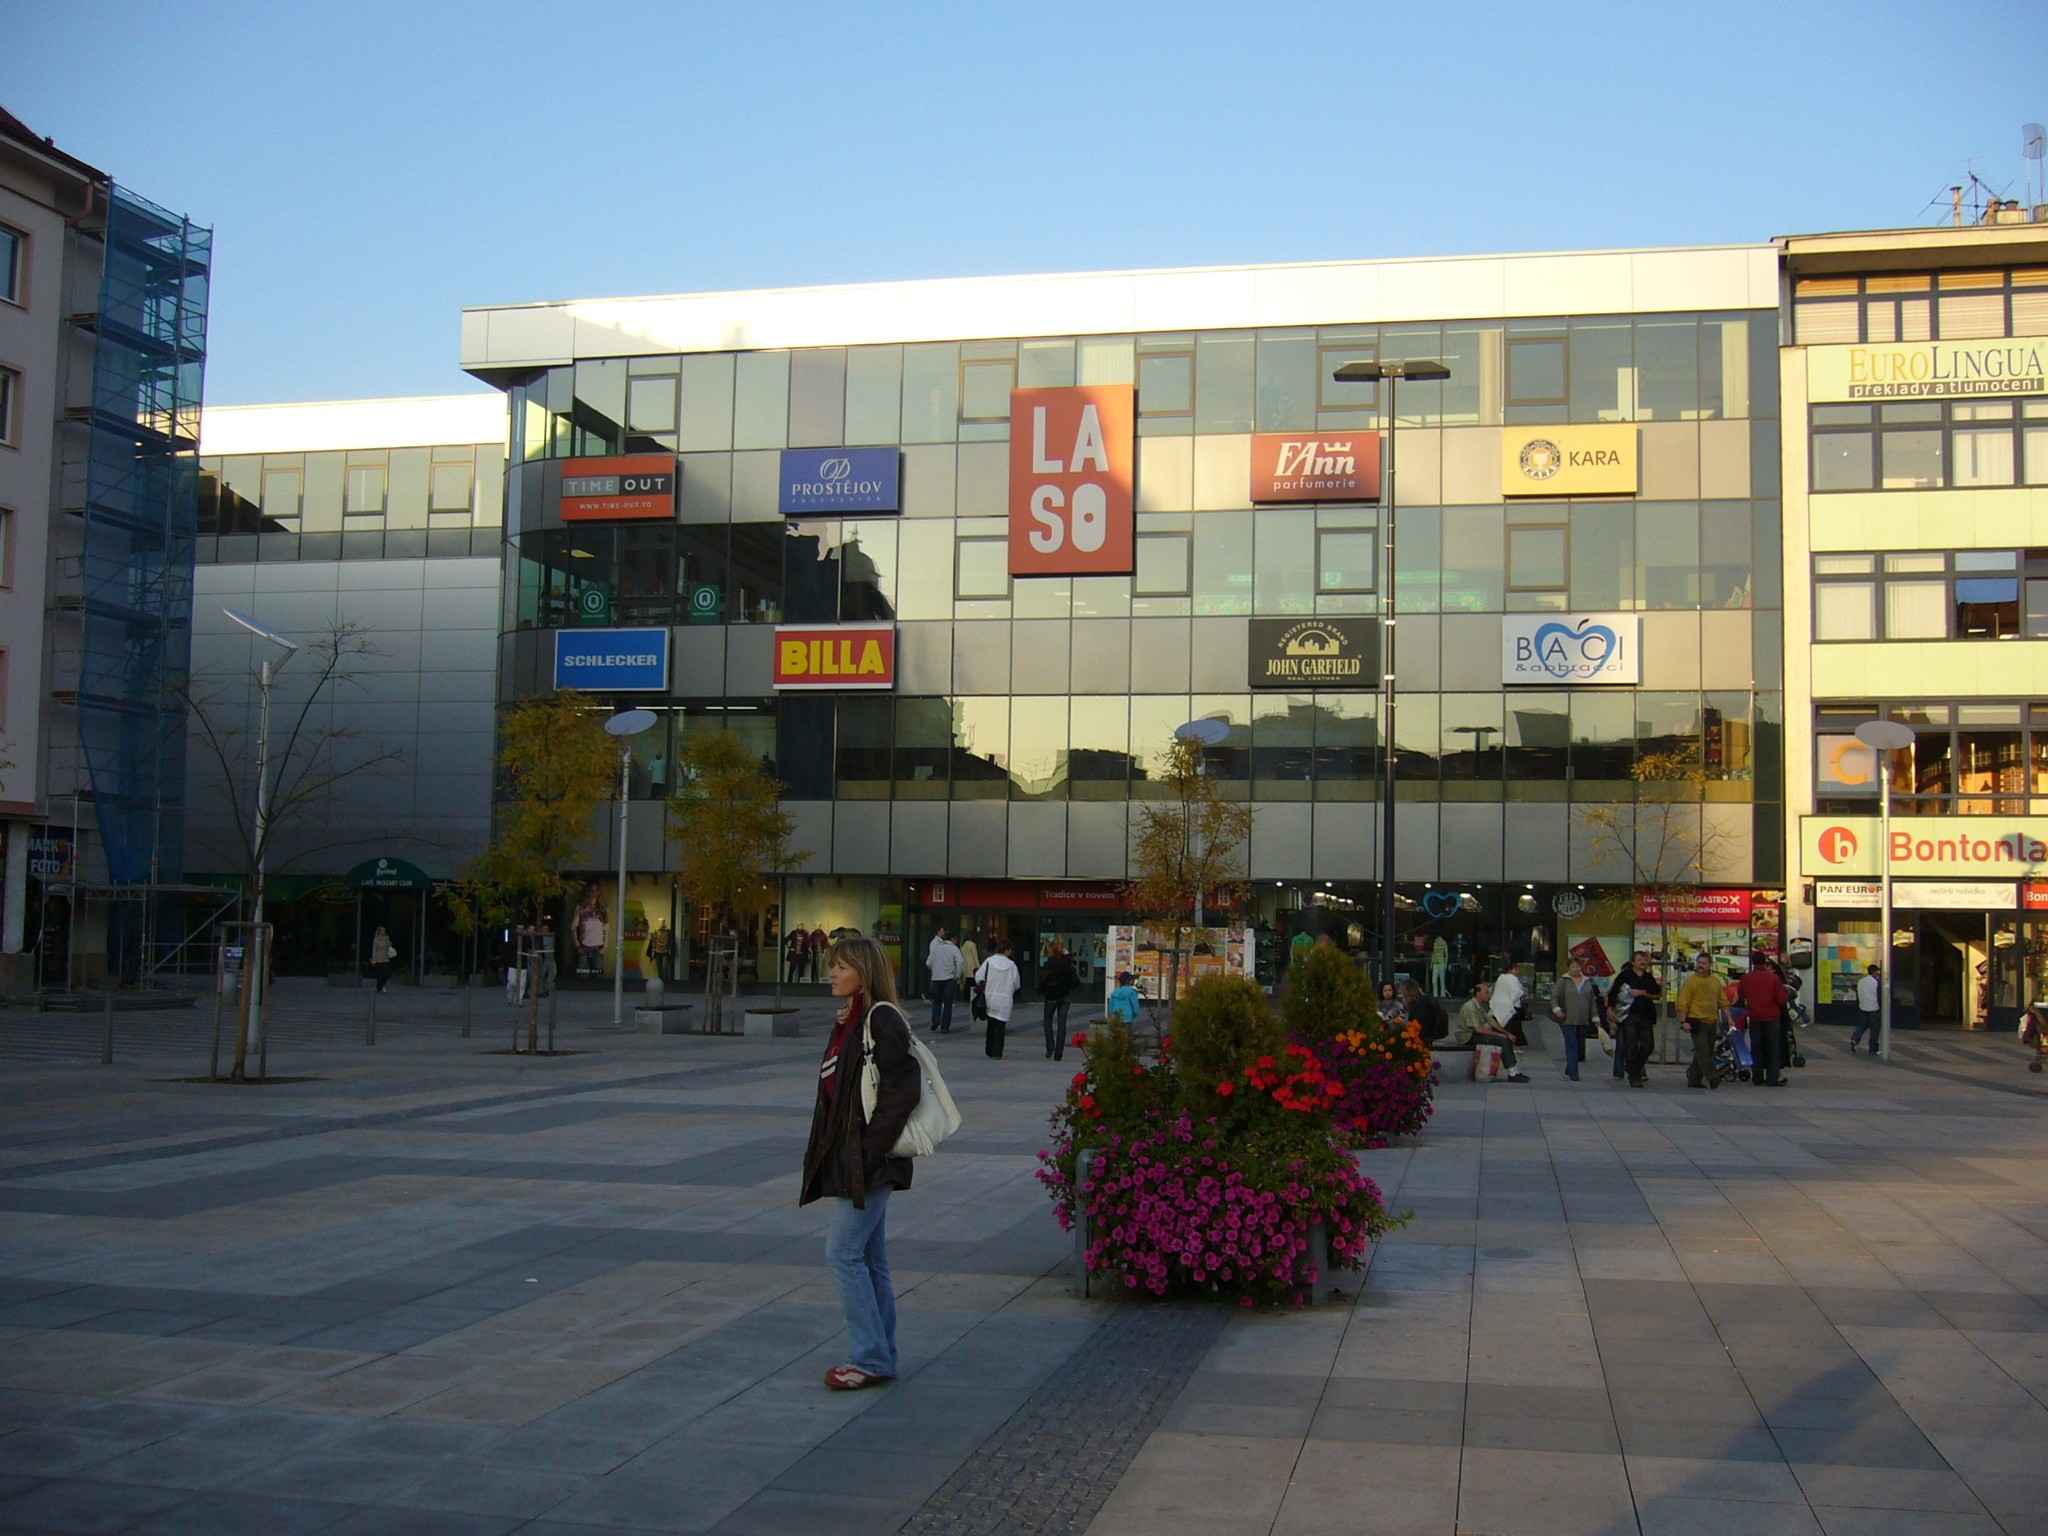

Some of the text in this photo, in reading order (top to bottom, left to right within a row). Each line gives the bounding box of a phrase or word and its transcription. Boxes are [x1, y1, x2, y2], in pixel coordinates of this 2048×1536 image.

[1935, 384, 1945, 393] a
[1032, 404, 1109, 473] LA
[1569, 450, 1621, 467] KARA
[568, 478, 665, 493] TIME OUT
[791, 480, 882, 496] PROSTĚJOV
[1273, 477, 1356, 491] parfumerie
[1029, 483, 1107, 553] SO
[1277, 621, 1348, 649] REGISTERED BRAND
[1516, 635, 1623, 661] BACI
[564, 655, 657, 667] SCHLECKER
[781, 640, 885, 675] BILLA
[1265, 658, 1360, 675] JOHN GARFIELD
[31, 859, 60, 874] FOTO
[1044, 890, 1076, 899] Tradice
